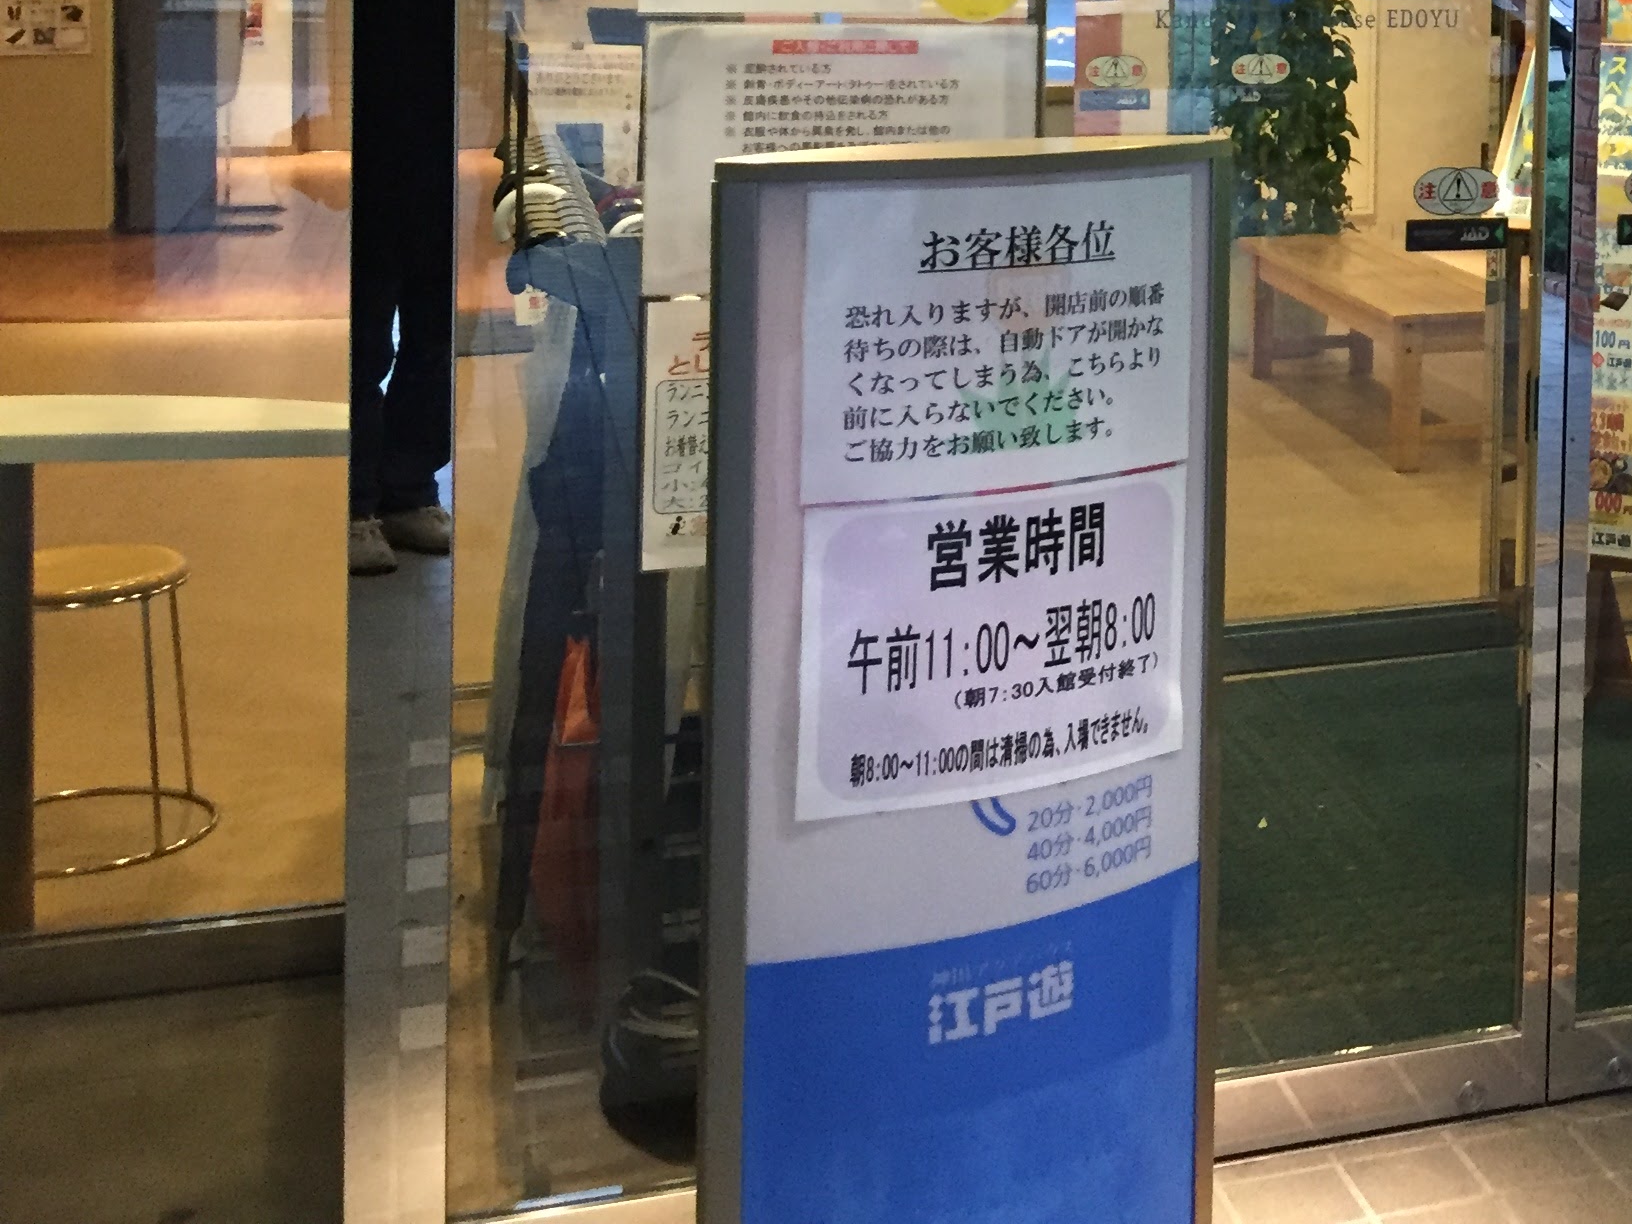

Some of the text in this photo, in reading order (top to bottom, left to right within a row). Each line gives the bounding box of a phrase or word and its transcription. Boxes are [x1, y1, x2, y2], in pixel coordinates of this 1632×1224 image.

[1387, 8, 1460, 29] EDOYU
[921, 219, 1116, 270] お客様各位
[845, 281, 1166, 330] 恐れ入りますが、開店前の順番
[843, 314, 1164, 365] 待ちの際は、自動ドアが開かな
[846, 345, 1161, 398] くなってしまう為、こちらより
[842, 385, 1115, 430] 前に入らないでください。
[843, 417, 1114, 464] ご協力をお願い致します。
[927, 501, 1105, 592] 営業時間
[928, 959, 1075, 1045] 江戸遊
